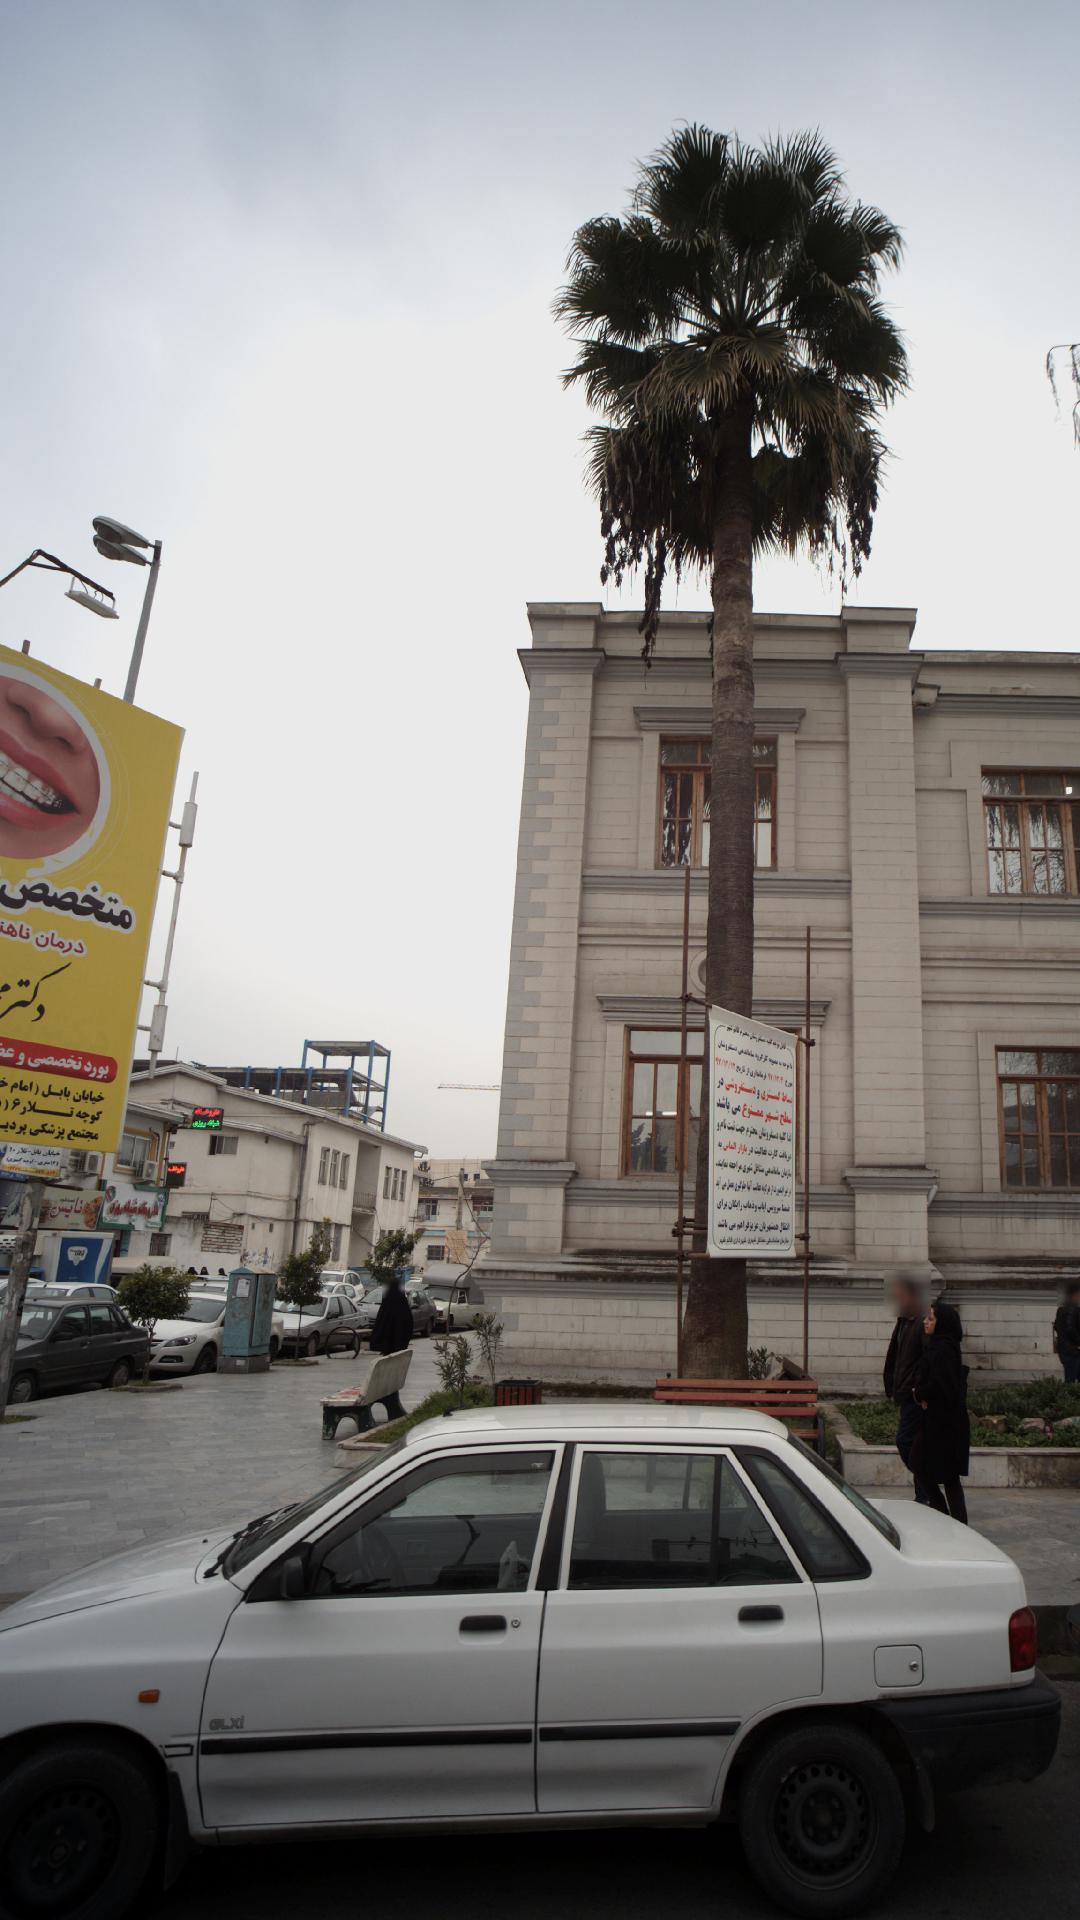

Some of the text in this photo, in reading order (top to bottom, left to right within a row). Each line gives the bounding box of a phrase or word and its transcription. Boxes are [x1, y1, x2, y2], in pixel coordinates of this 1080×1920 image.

[0, 883, 133, 929] متخصص
[35, 932, 85, 954] درمان
[16, 1052, 25, 1065] و
[27, 1055, 82, 1070] تخصصی
[84, 1060, 109, 1078] بورد
[73, 1090, 104, 1104] خیابان
[76, 1111, 102, 1124] کوچه
[30, 1123, 65, 1140] پزشکی
[67, 1131, 99, 1142] مجتمع
